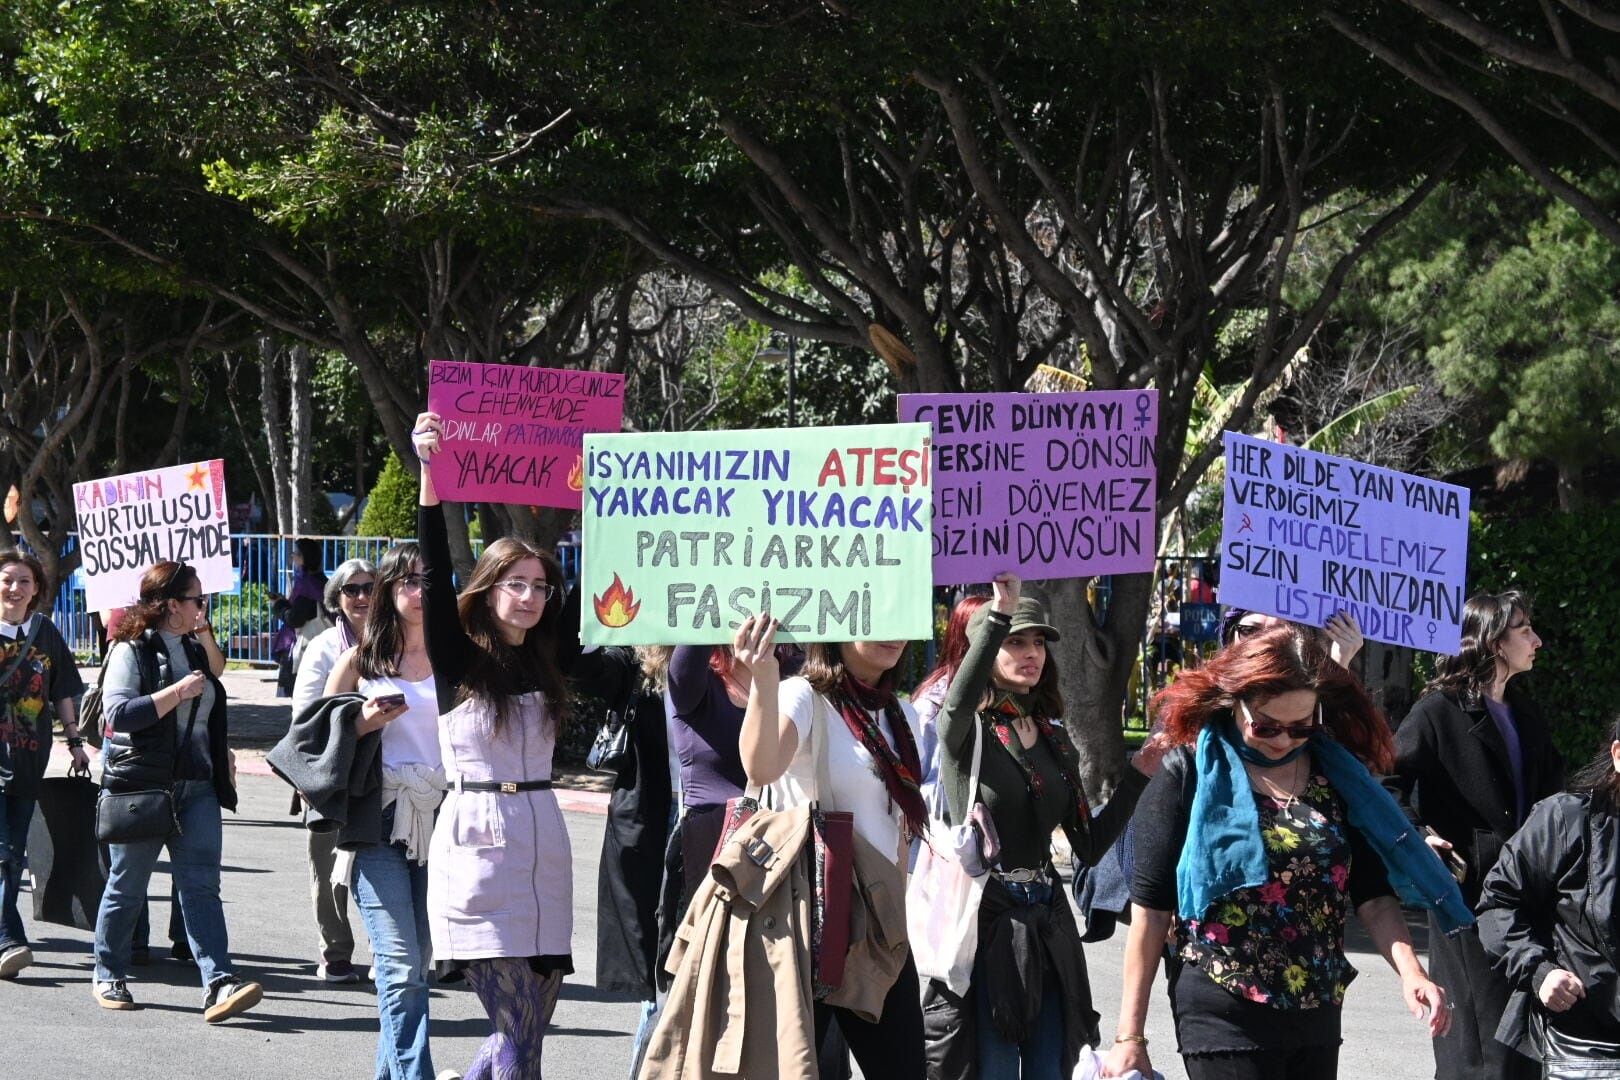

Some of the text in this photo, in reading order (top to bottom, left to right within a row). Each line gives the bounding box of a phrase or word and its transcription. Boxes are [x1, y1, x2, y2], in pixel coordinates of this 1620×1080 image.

[455, 391, 588, 422] CEHENNEMDE
[1012, 399, 1123, 432] DÜNYAYI
[441, 419, 503, 447] ADINLAR
[1047, 426, 1157, 472] DÖNSÜN
[454, 449, 558, 489] YAKACAK
[588, 437, 931, 493] İSYANIMIZIN ATEŞİ
[1232, 441, 1461, 519] HER DİLDE YAN YANA
[77, 473, 163, 511] KADININ
[589, 486, 924, 533] YAKACAK YIKACAK
[1008, 478, 1152, 516] DÖVEMEZ
[1230, 477, 1361, 529] VERDİĞİMİZ
[636, 526, 901, 569] PATRİARKAL
[1017, 511, 1141, 565] DÖVSÜN
[1268, 516, 1446, 576] MÜCADELEMİZ
[1227, 538, 1461, 626] SİZİN IRKINIZDAN
